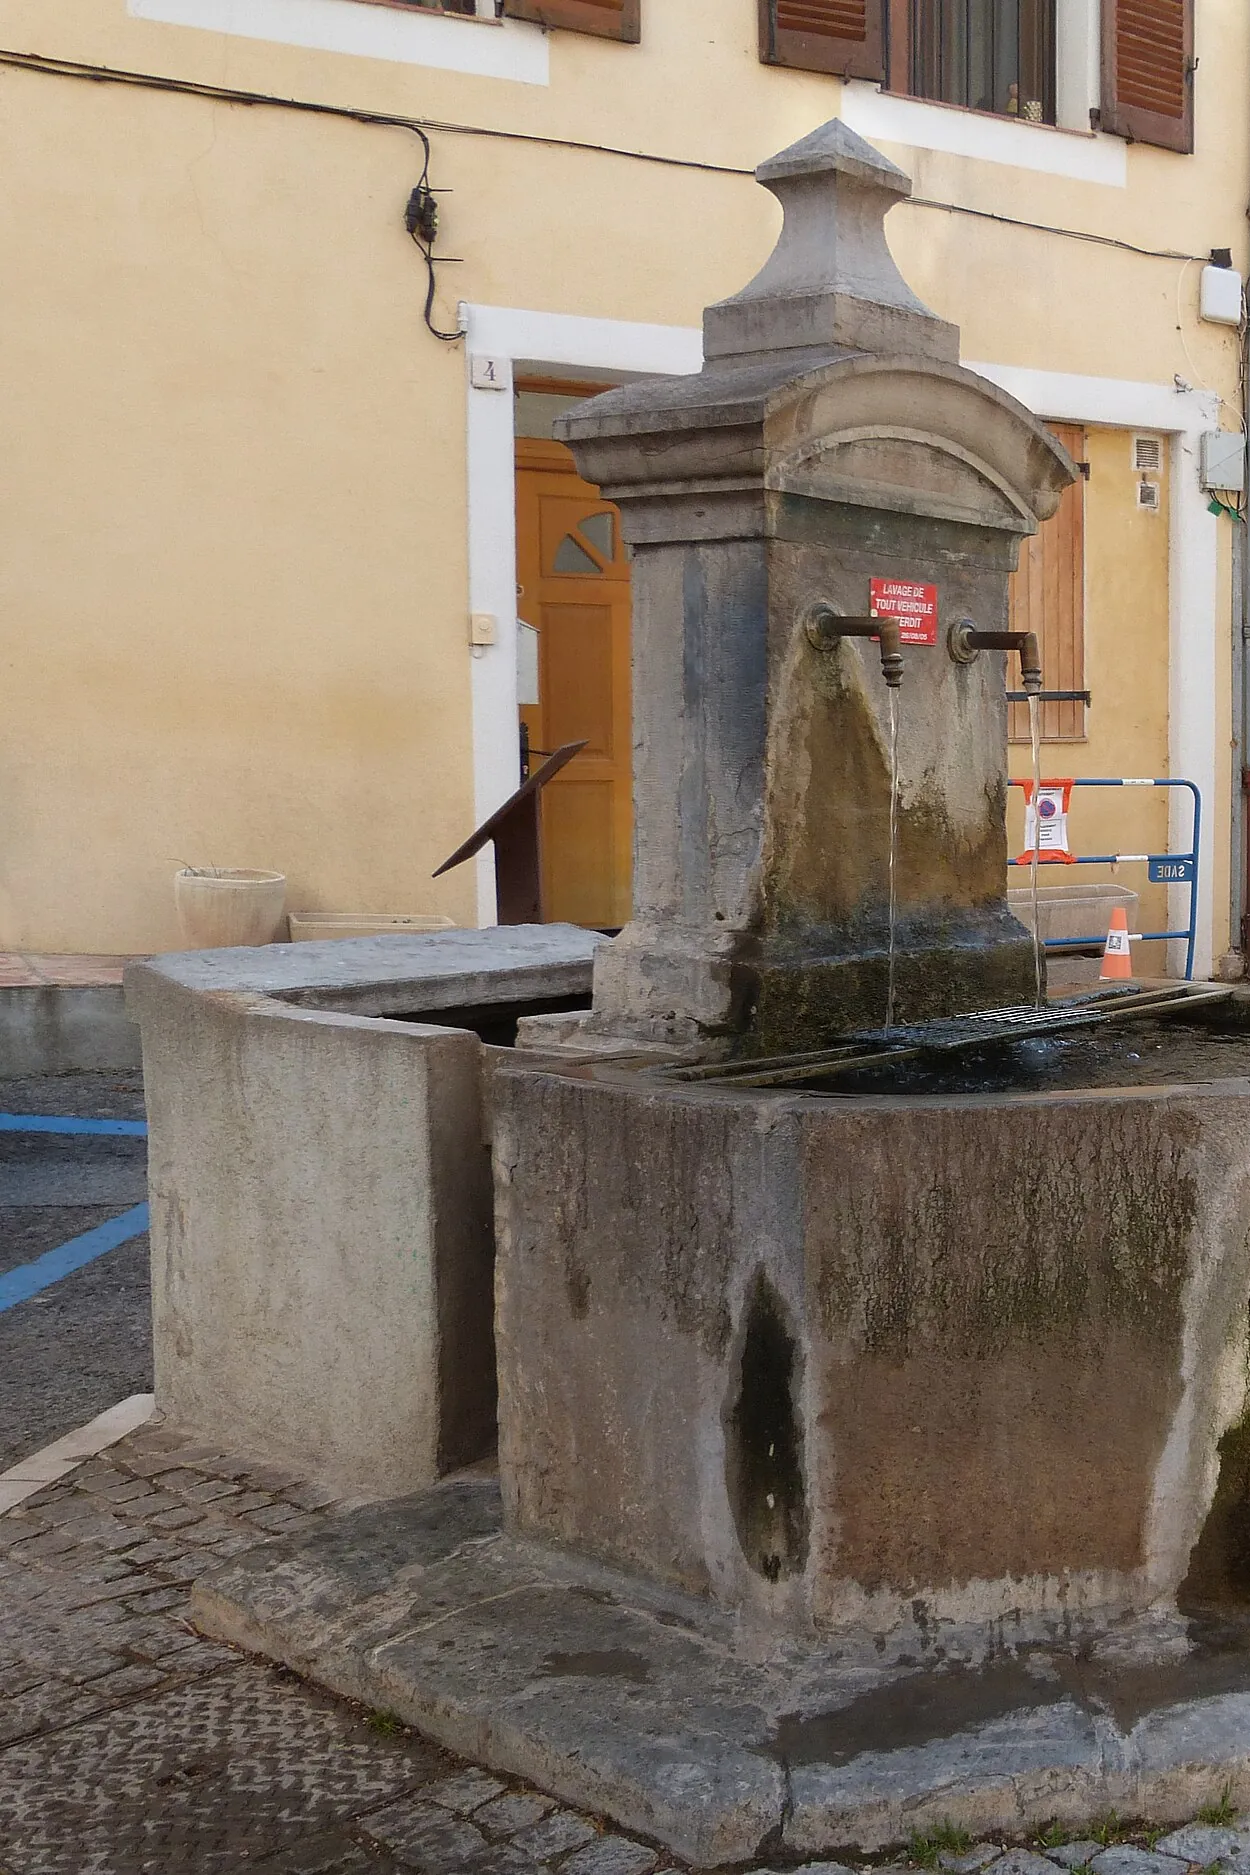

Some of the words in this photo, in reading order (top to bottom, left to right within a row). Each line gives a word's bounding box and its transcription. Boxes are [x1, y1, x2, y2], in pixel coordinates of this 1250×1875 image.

[483, 360, 496, 381] 4
[883, 583, 912, 597] LAVAGE
[913, 587, 924, 598] DE
[876, 598, 896, 611] TOUT
[897, 601, 933, 614] VEHICULE
[888, 615, 923, 628] ERDIT
